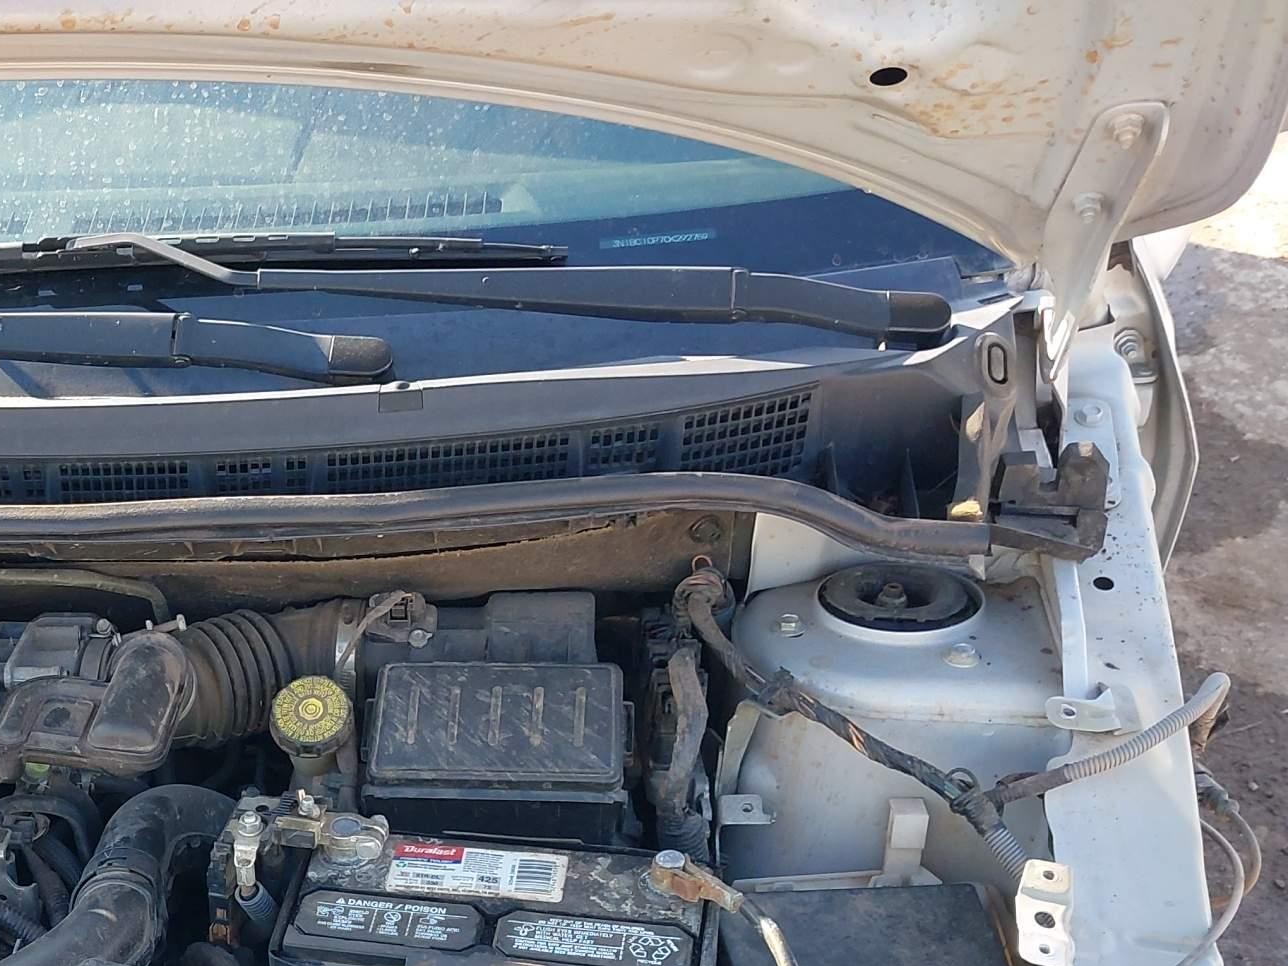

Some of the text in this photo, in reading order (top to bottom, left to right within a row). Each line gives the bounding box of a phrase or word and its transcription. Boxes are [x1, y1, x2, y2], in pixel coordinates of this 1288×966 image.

[403, 845, 457, 856] Duralast
[478, 875, 498, 884] 425
[347, 898, 394, 909] DANGER
[404, 904, 447, 914] POISON
